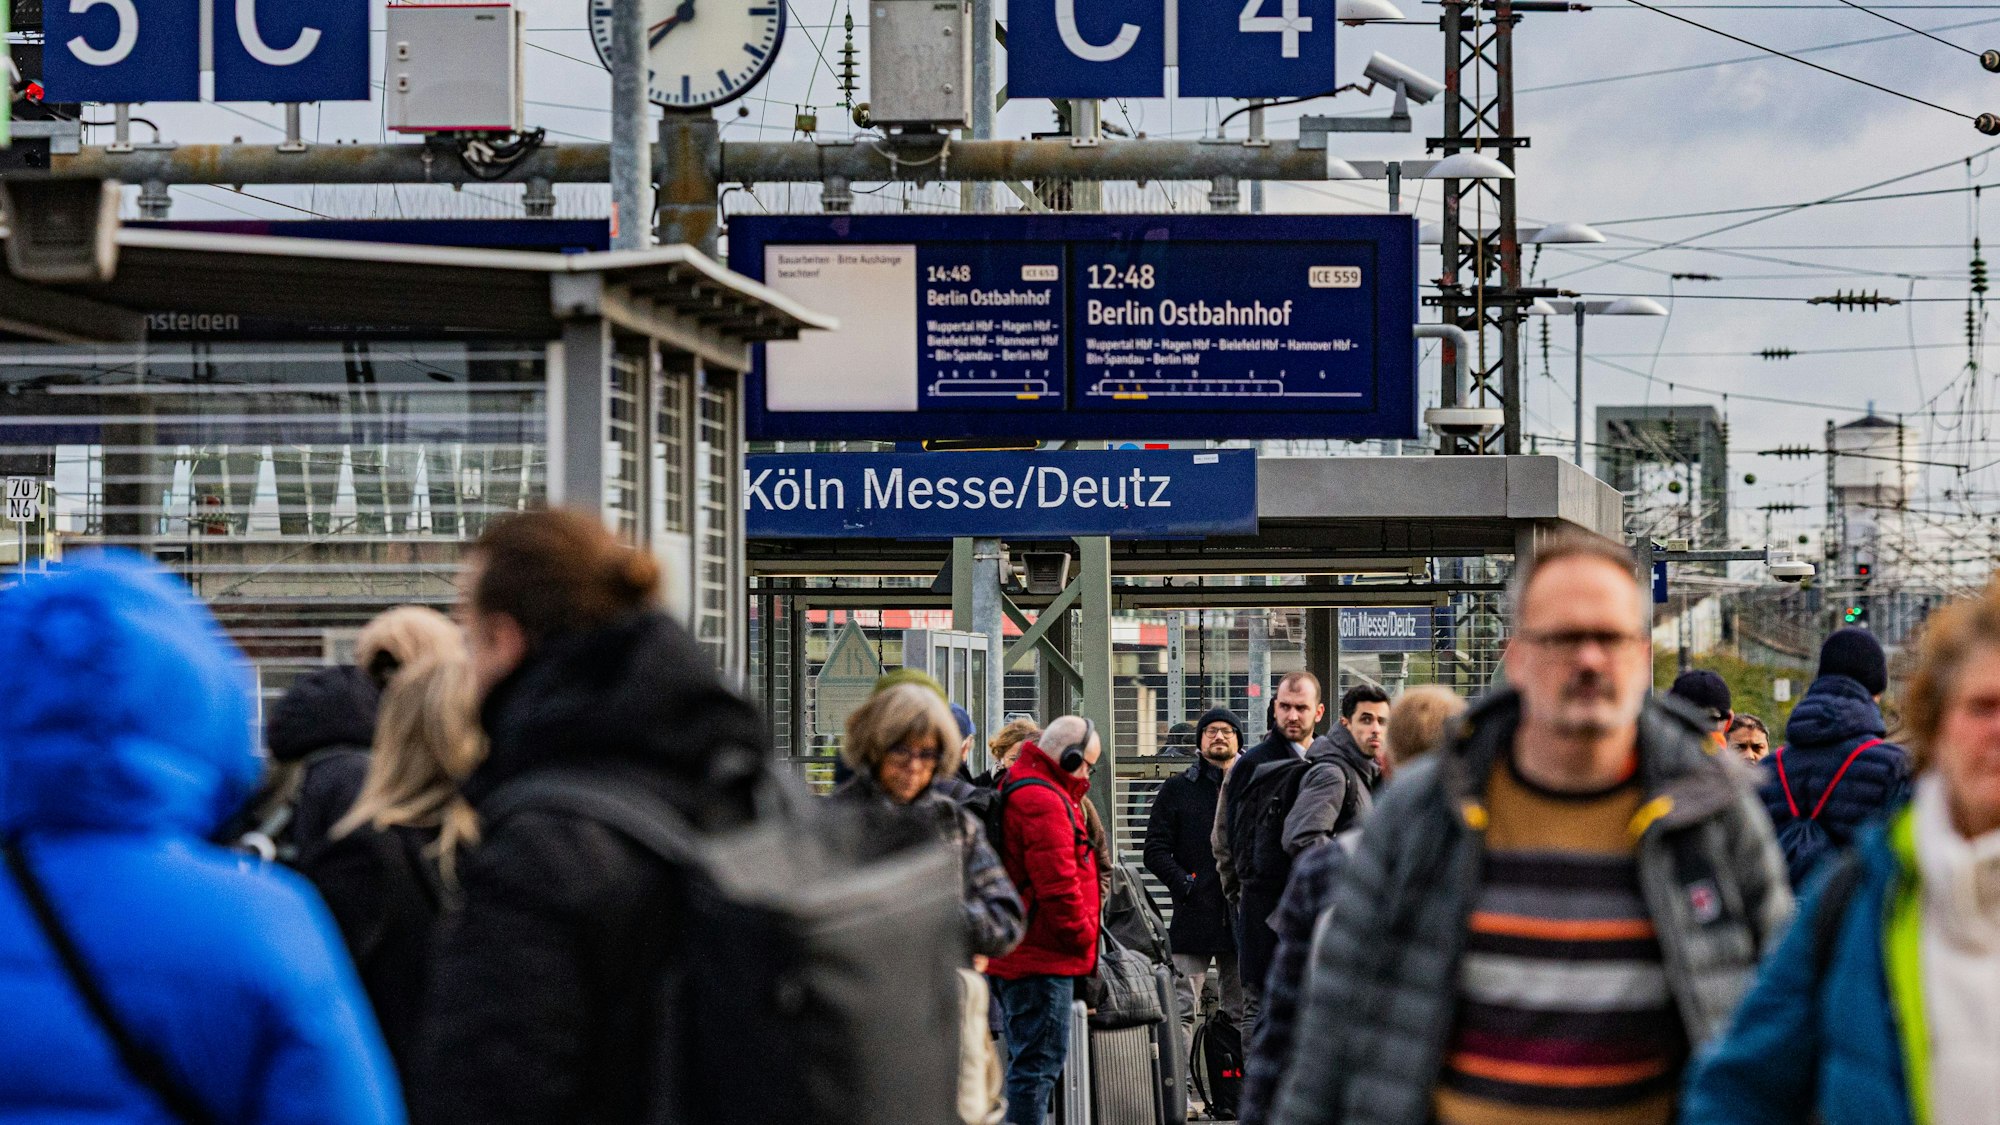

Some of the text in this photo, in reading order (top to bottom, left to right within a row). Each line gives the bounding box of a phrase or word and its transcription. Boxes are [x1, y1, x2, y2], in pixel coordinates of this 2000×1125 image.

[927, 265, 971, 282] 14:48
[1088, 264, 1155, 289] 12:48
[1312, 270, 1359, 284] ICE 559
[927, 288, 1051, 306] Berlin Ostbahnhof
[1087, 299, 1293, 326] Berlin Ostbahnhof
[1086, 338, 1134, 351] Wuppertal
[1161, 338, 1191, 352] Hagen
[1219, 339, 1260, 350] Bielefeld
[1261, 339, 1279, 350] Hbf
[1287, 339, 1331, 350] Hannover
[1333, 339, 1350, 351] Hbf
[1153, 353, 1181, 365] Berlin
[13, 480, 29, 496] 70
[744, 466, 1171, 511] Köln Messe/Deutz
[11, 500, 30, 517] N6
[1358, 611, 1416, 637] Messe/Deutz
